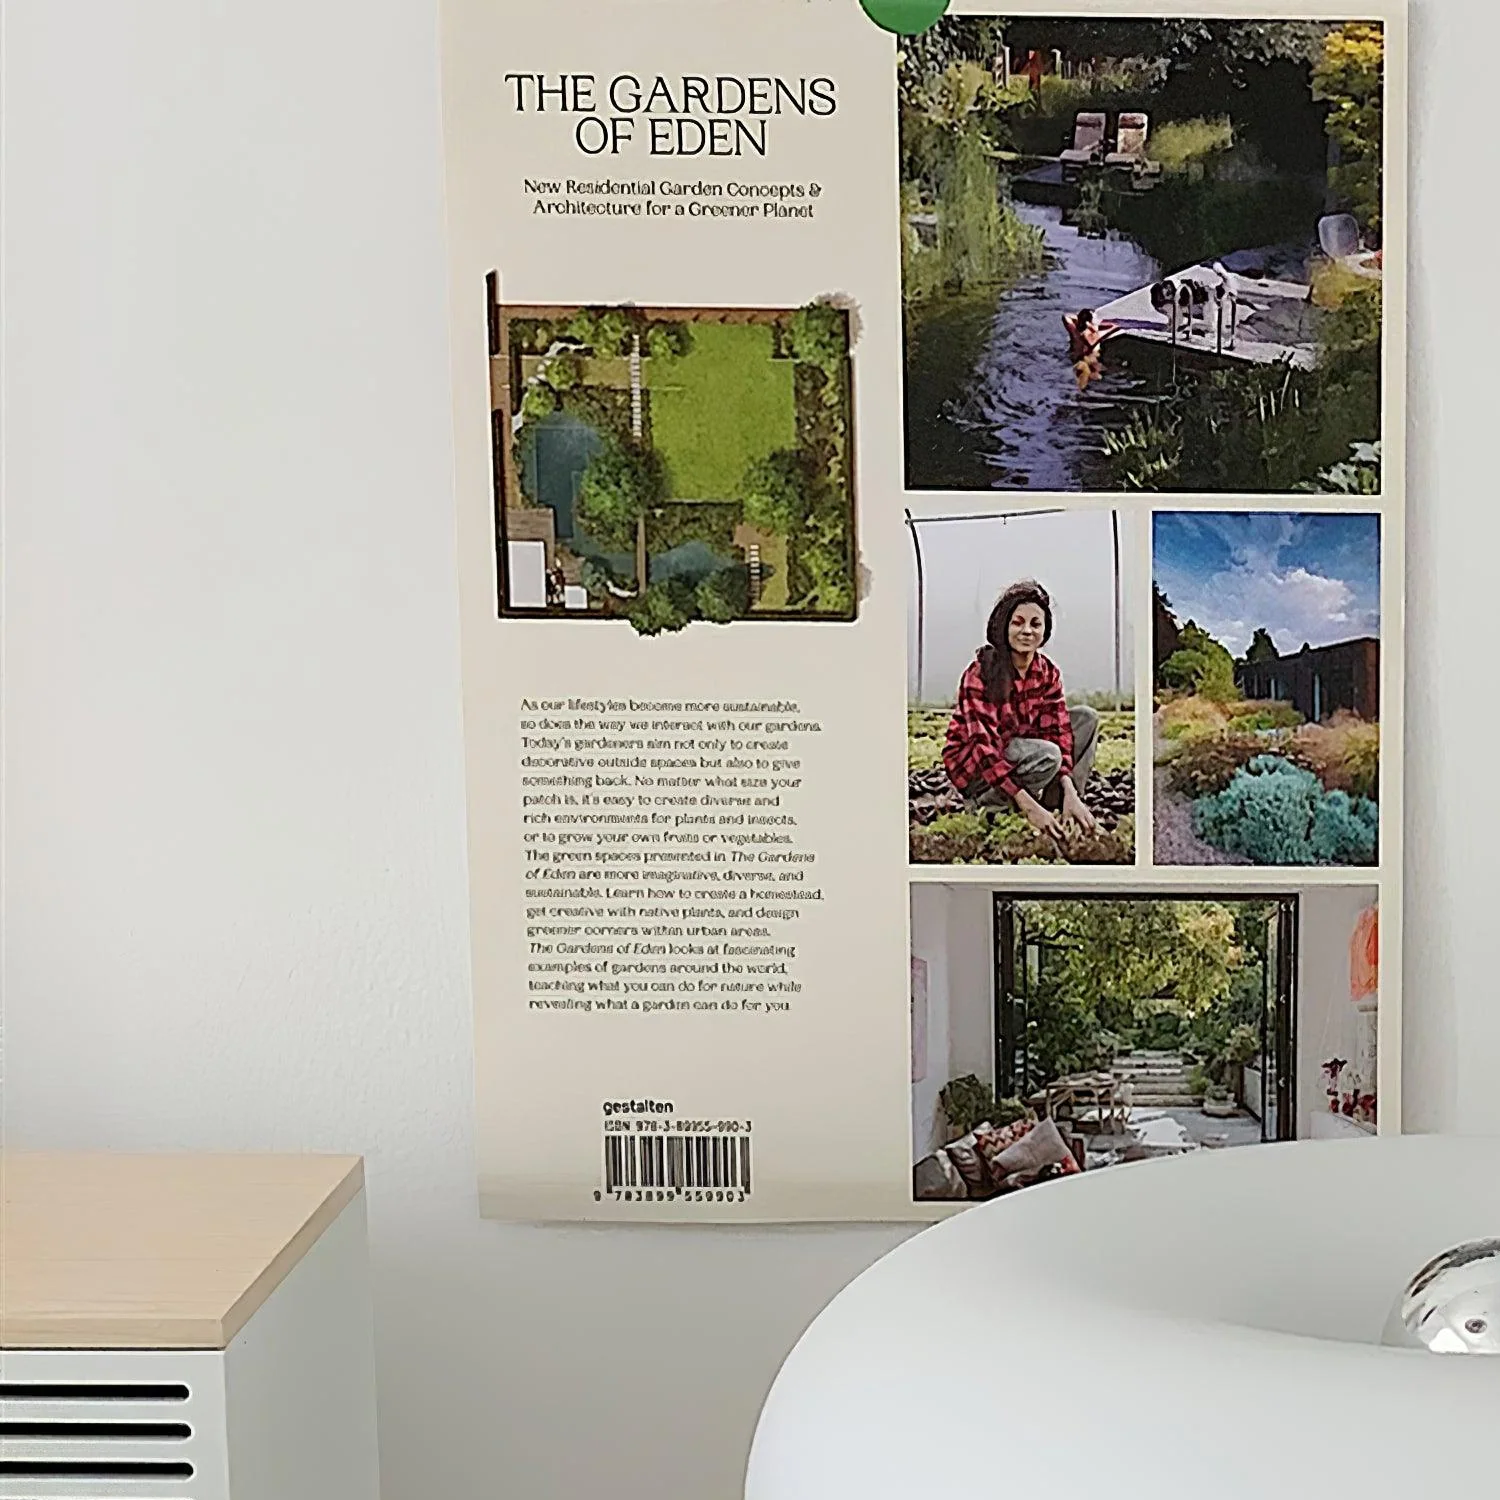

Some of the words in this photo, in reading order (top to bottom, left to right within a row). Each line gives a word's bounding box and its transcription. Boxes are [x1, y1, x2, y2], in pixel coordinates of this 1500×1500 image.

[504, 74, 597, 112] THE
[609, 74, 837, 116] GARDENS
[575, 117, 635, 154] OF
[649, 118, 767, 156] EDEN
[524, 179, 561, 194] New
[566, 179, 656, 195] Residential
[659, 180, 723, 196] Garden
[726, 182, 805, 200] Concepts
[533, 200, 641, 215] Architecture
[646, 200, 671, 216] for
[674, 204, 685, 216] a
[688, 202, 759, 217] Greener
[763, 202, 814, 217] Planet
[521, 698, 538, 712] As
[541, 701, 565, 712] our
[685, 702, 719, 713] more
[521, 720, 536, 730] so
[539, 716, 571, 730] does
[574, 717, 595, 731] the
[599, 720, 625, 734] way
[630, 720, 648, 731] we
[707, 718, 735, 732] with
[739, 721, 762, 732] our
[675, 738, 694, 750] not
[698, 736, 726, 753] only
[730, 738, 743, 750] to
[700, 755, 722, 769] but
[726, 755, 753, 769] also
[756, 756, 769, 769] to
[773, 757, 800, 772] give
[635, 773, 654, 787] No
[705, 774, 737, 788] what
[771, 778, 801, 791] your
[582, 794, 599, 806] it's
[603, 796, 634, 809] easy
[638, 794, 651, 806] to
[755, 793, 779, 807] and
[524, 811, 551, 825] rich
[652, 811, 671, 825] for
[719, 812, 744, 826] and
[524, 833, 539, 843] or
[543, 831, 555, 843] to
[559, 833, 593, 846] grow
[597, 833, 628, 847] your
[632, 833, 660, 844] own
[703, 834, 717, 844] or
[526, 848, 549, 862] The
[714, 850, 726, 863] in
[731, 849, 755, 863] The
[526, 866, 540, 880] of
[543, 866, 576, 880] Eden
[579, 870, 601, 881] are
[605, 870, 639, 881] more
[779, 868, 803, 882] and
[648, 886, 675, 900] how
[679, 887, 691, 900] to
[739, 889, 747, 900] a
[527, 905, 545, 921] get
[607, 904, 636, 918] with
[728, 905, 753, 919] and
[531, 941, 553, 955] The
[617, 941, 629, 955] of
[633, 941, 666, 955] Eden
[707, 943, 719, 956] at
[595, 959, 607, 973] of
[722, 960, 743, 974] the
[588, 978, 619, 992] what
[624, 981, 648, 995] you
[651, 982, 675, 992] can
[678, 978, 695, 992] do
[699, 978, 717, 992] for
[596, 997, 627, 1011] what
[631, 1000, 639, 1011] a
[693, 1001, 717, 1011] can
[721, 997, 738, 1011] do
[742, 998, 761, 1012] for
[603, 1099, 674, 1116] gestalten
